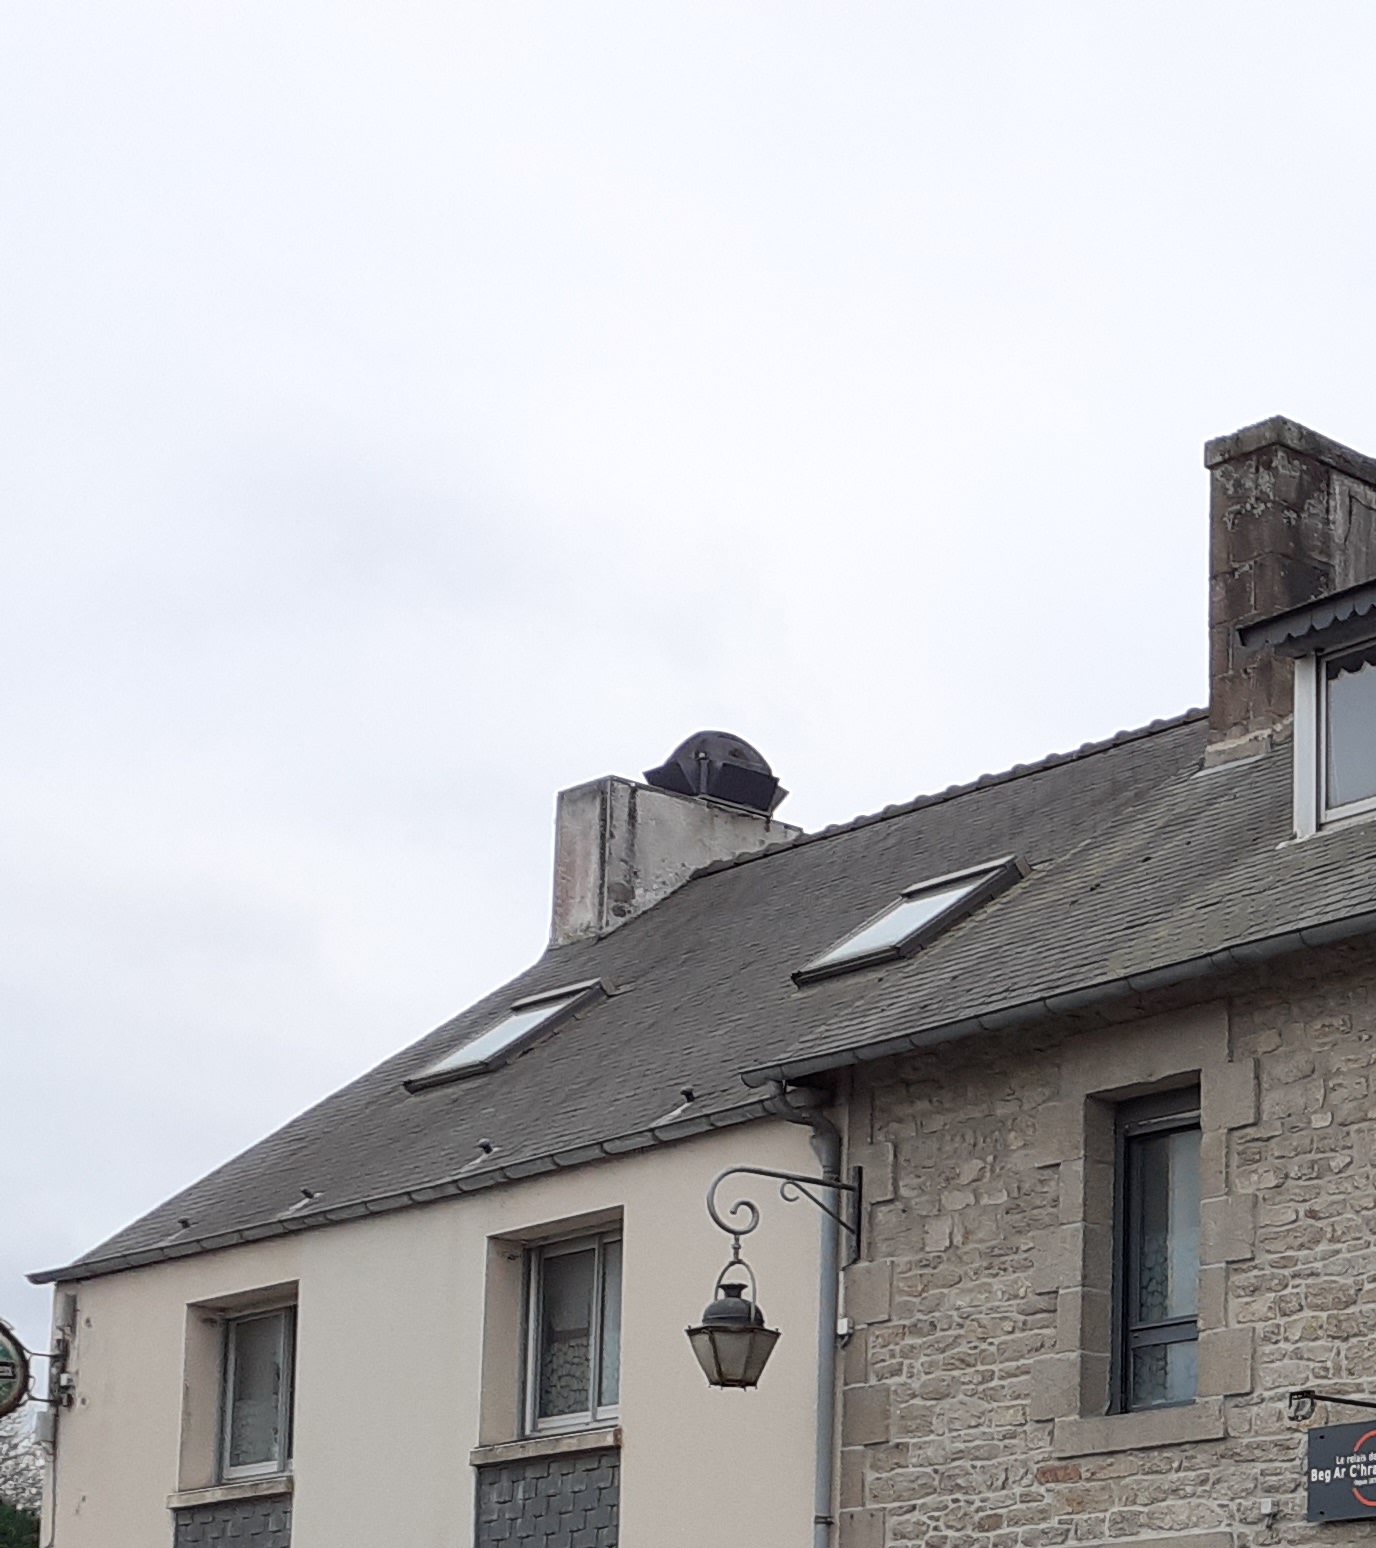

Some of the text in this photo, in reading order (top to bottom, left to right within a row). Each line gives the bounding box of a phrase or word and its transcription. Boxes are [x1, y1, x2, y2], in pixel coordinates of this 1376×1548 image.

[1335, 1456, 1345, 1465] Le
[1311, 1469, 1331, 1483] Beg
[1333, 1466, 1346, 1479] Ar
